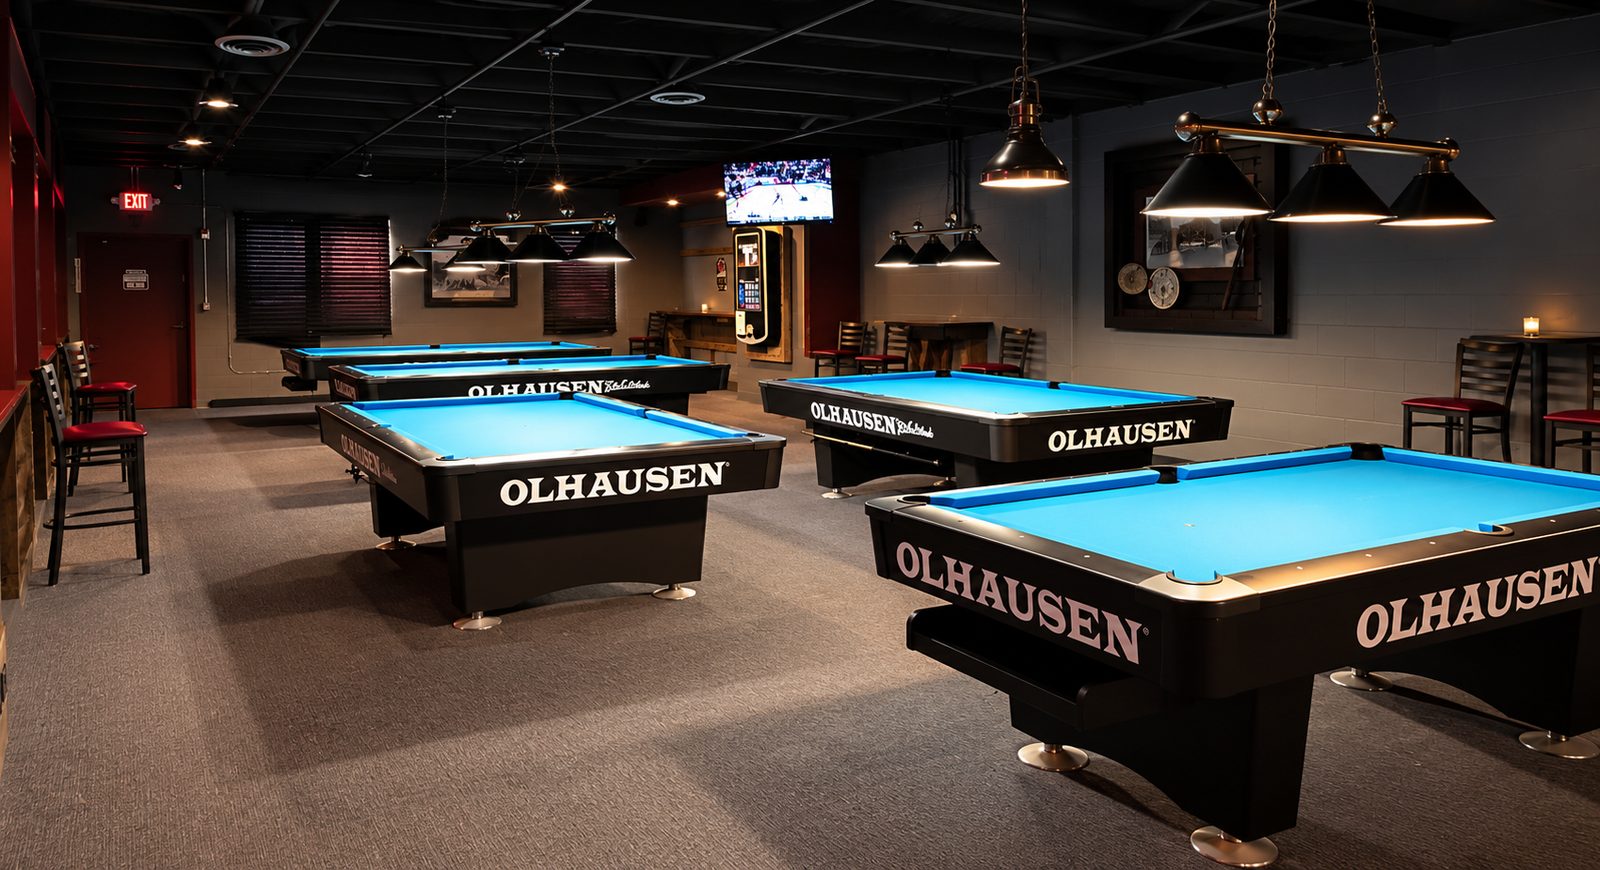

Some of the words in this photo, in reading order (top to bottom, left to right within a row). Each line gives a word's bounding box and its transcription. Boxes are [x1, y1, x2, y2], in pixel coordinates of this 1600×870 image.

[124, 193, 148, 209] EXIT
[468, 380, 604, 397] OLHAUSEN
[810, 401, 897, 436] OLHAUSEN
[1048, 420, 1192, 452] OLHAUSEN
[500, 462, 725, 506] OLHAUSEN
[896, 541, 1142, 665] OLHAUSEN
[1357, 557, 1599, 649] OLHAUSEN
